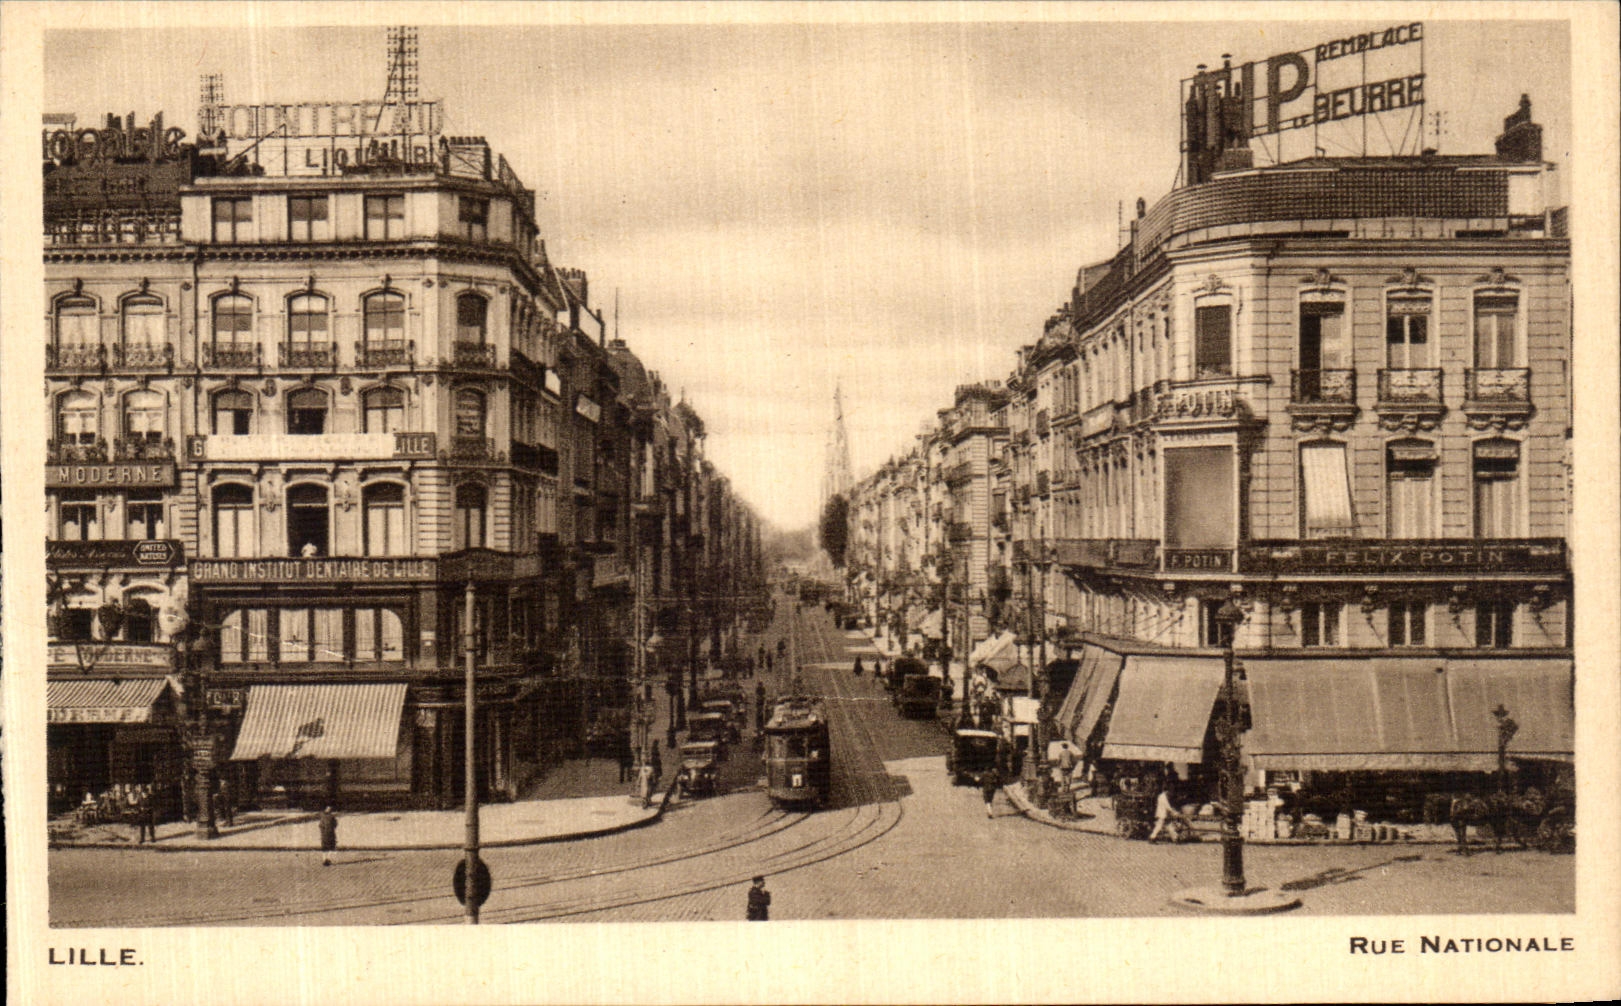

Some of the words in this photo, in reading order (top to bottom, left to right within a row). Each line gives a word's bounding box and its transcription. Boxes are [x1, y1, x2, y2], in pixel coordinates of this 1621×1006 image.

[1315, 22, 1423, 63] REMPLACE
[1314, 73, 1426, 124] BEURRE
[199, 99, 444, 141] COINTREAU
[58, 466, 163, 485] MODERNE
[1184, 554, 1222, 568] POTIN
[1326, 551, 1403, 564] FELIX
[1420, 551, 1504, 564] POTIN
[194, 561, 238, 579] GRAND
[243, 560, 300, 579] INSTITUT
[306, 560, 369, 578] DENTAIRE
[373, 561, 392, 578] DE
[393, 559, 431, 578] LILLE
